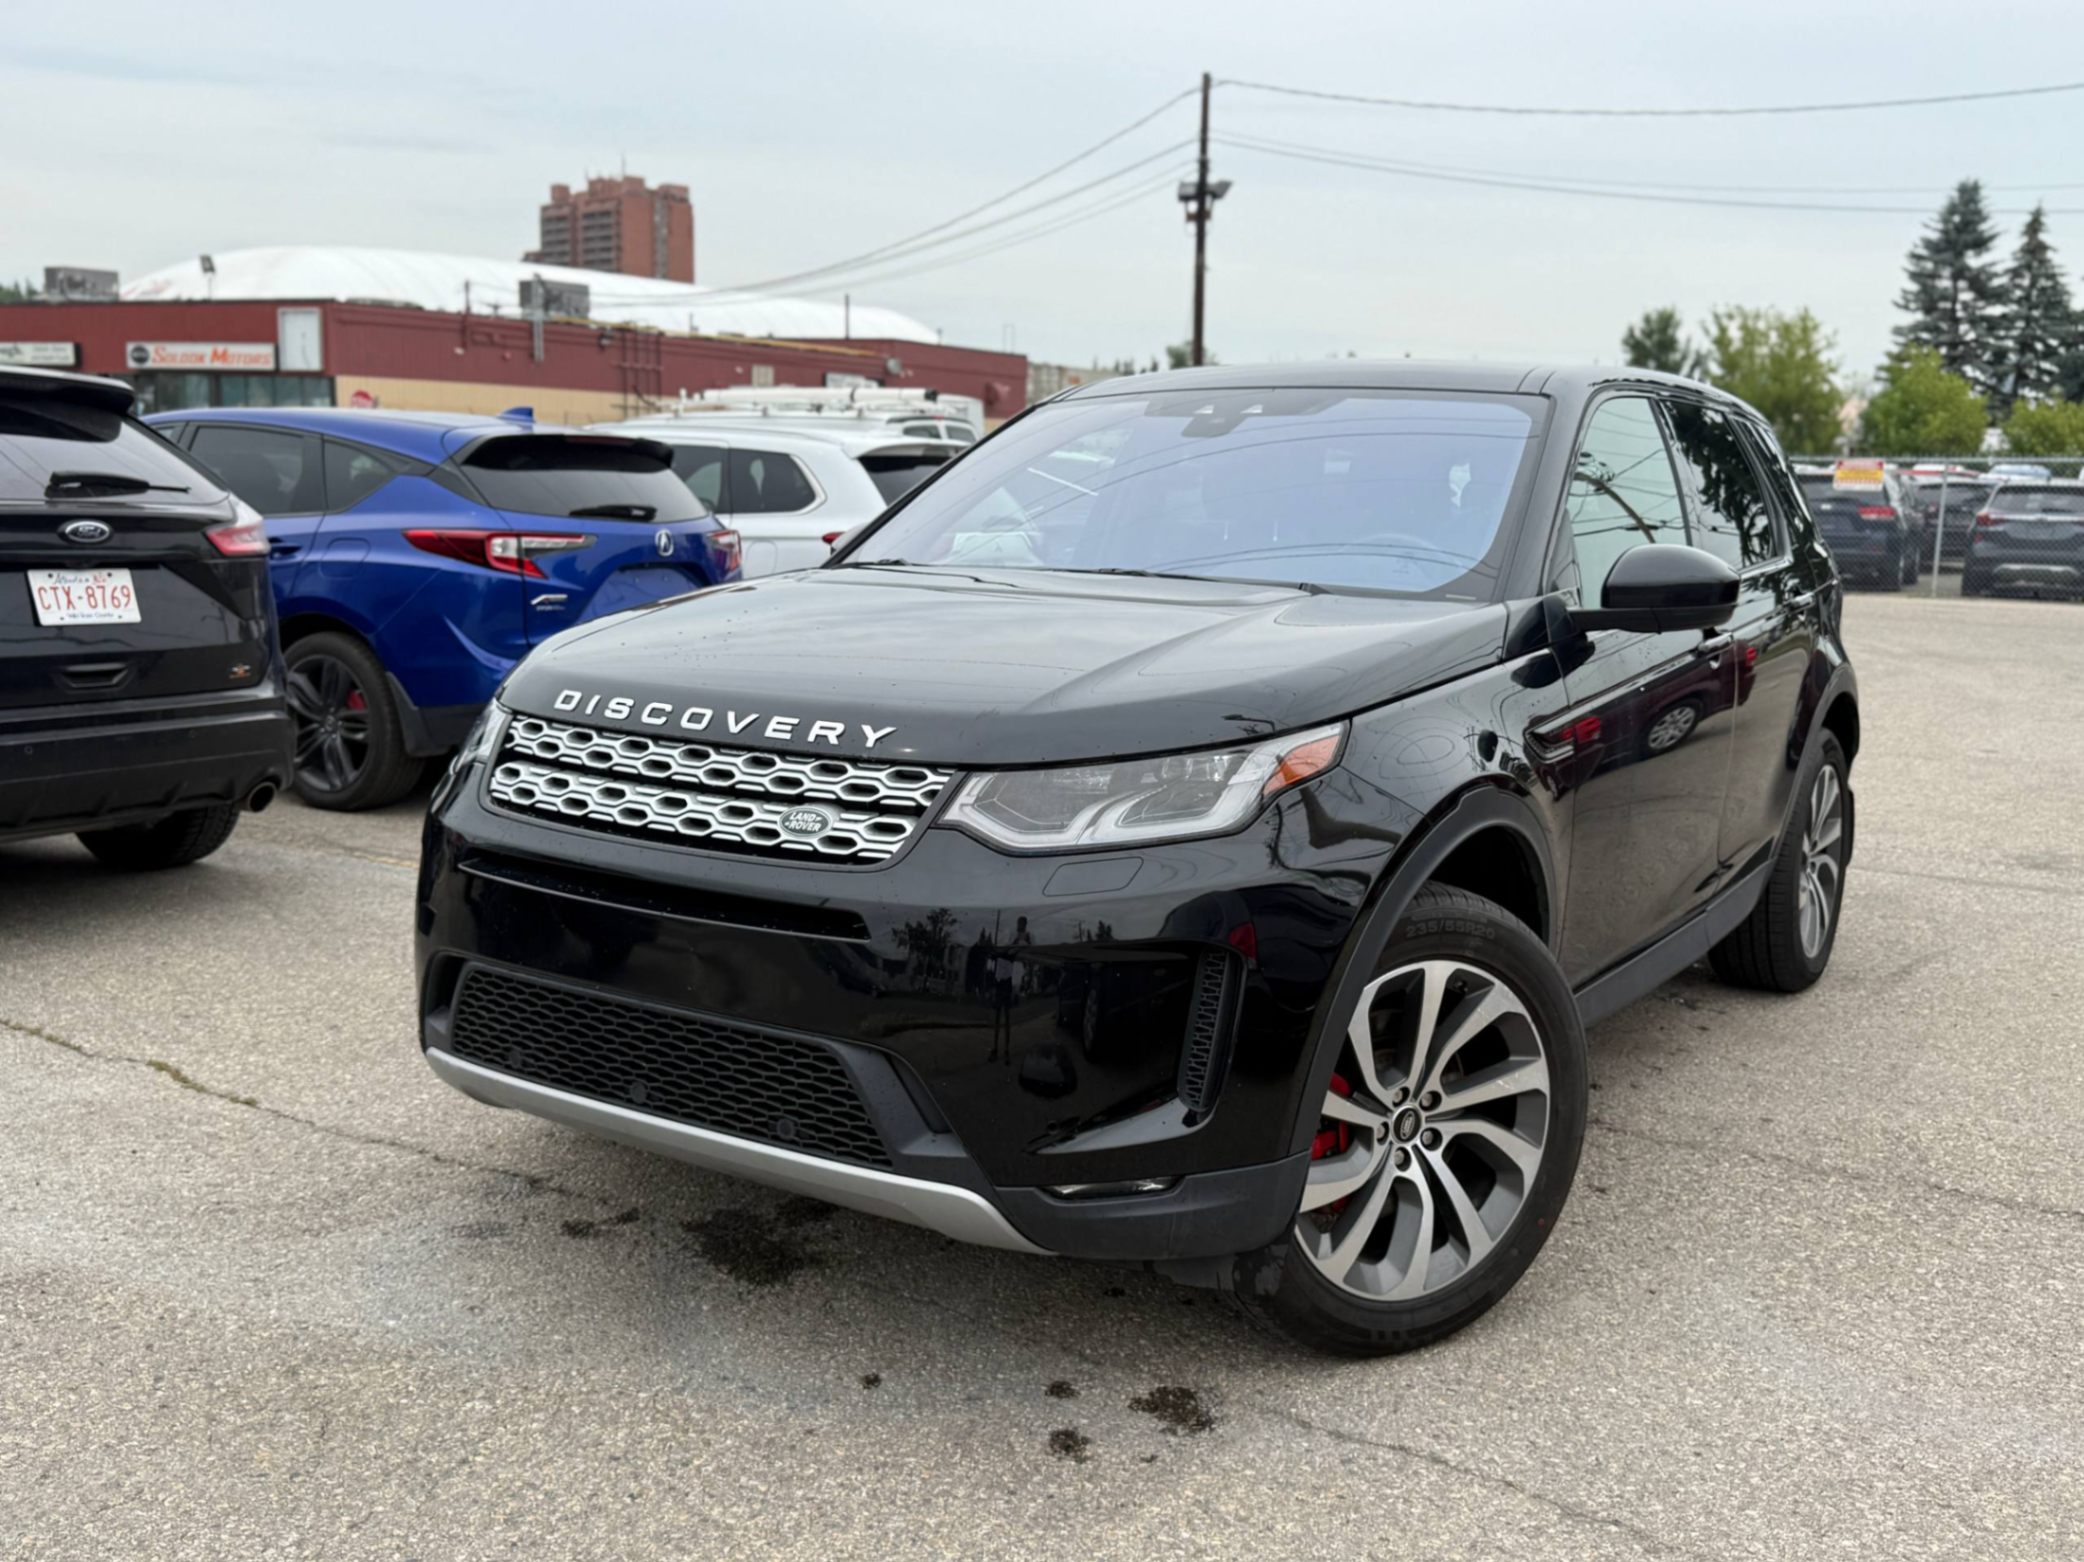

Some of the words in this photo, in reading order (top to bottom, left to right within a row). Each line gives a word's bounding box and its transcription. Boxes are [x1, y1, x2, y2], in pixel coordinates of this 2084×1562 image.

[38, 585, 131, 610] CTX-8769
[553, 689, 897, 748] DISCOVERY
[790, 812, 817, 822] LAND
[789, 821, 821, 831] ROVER
